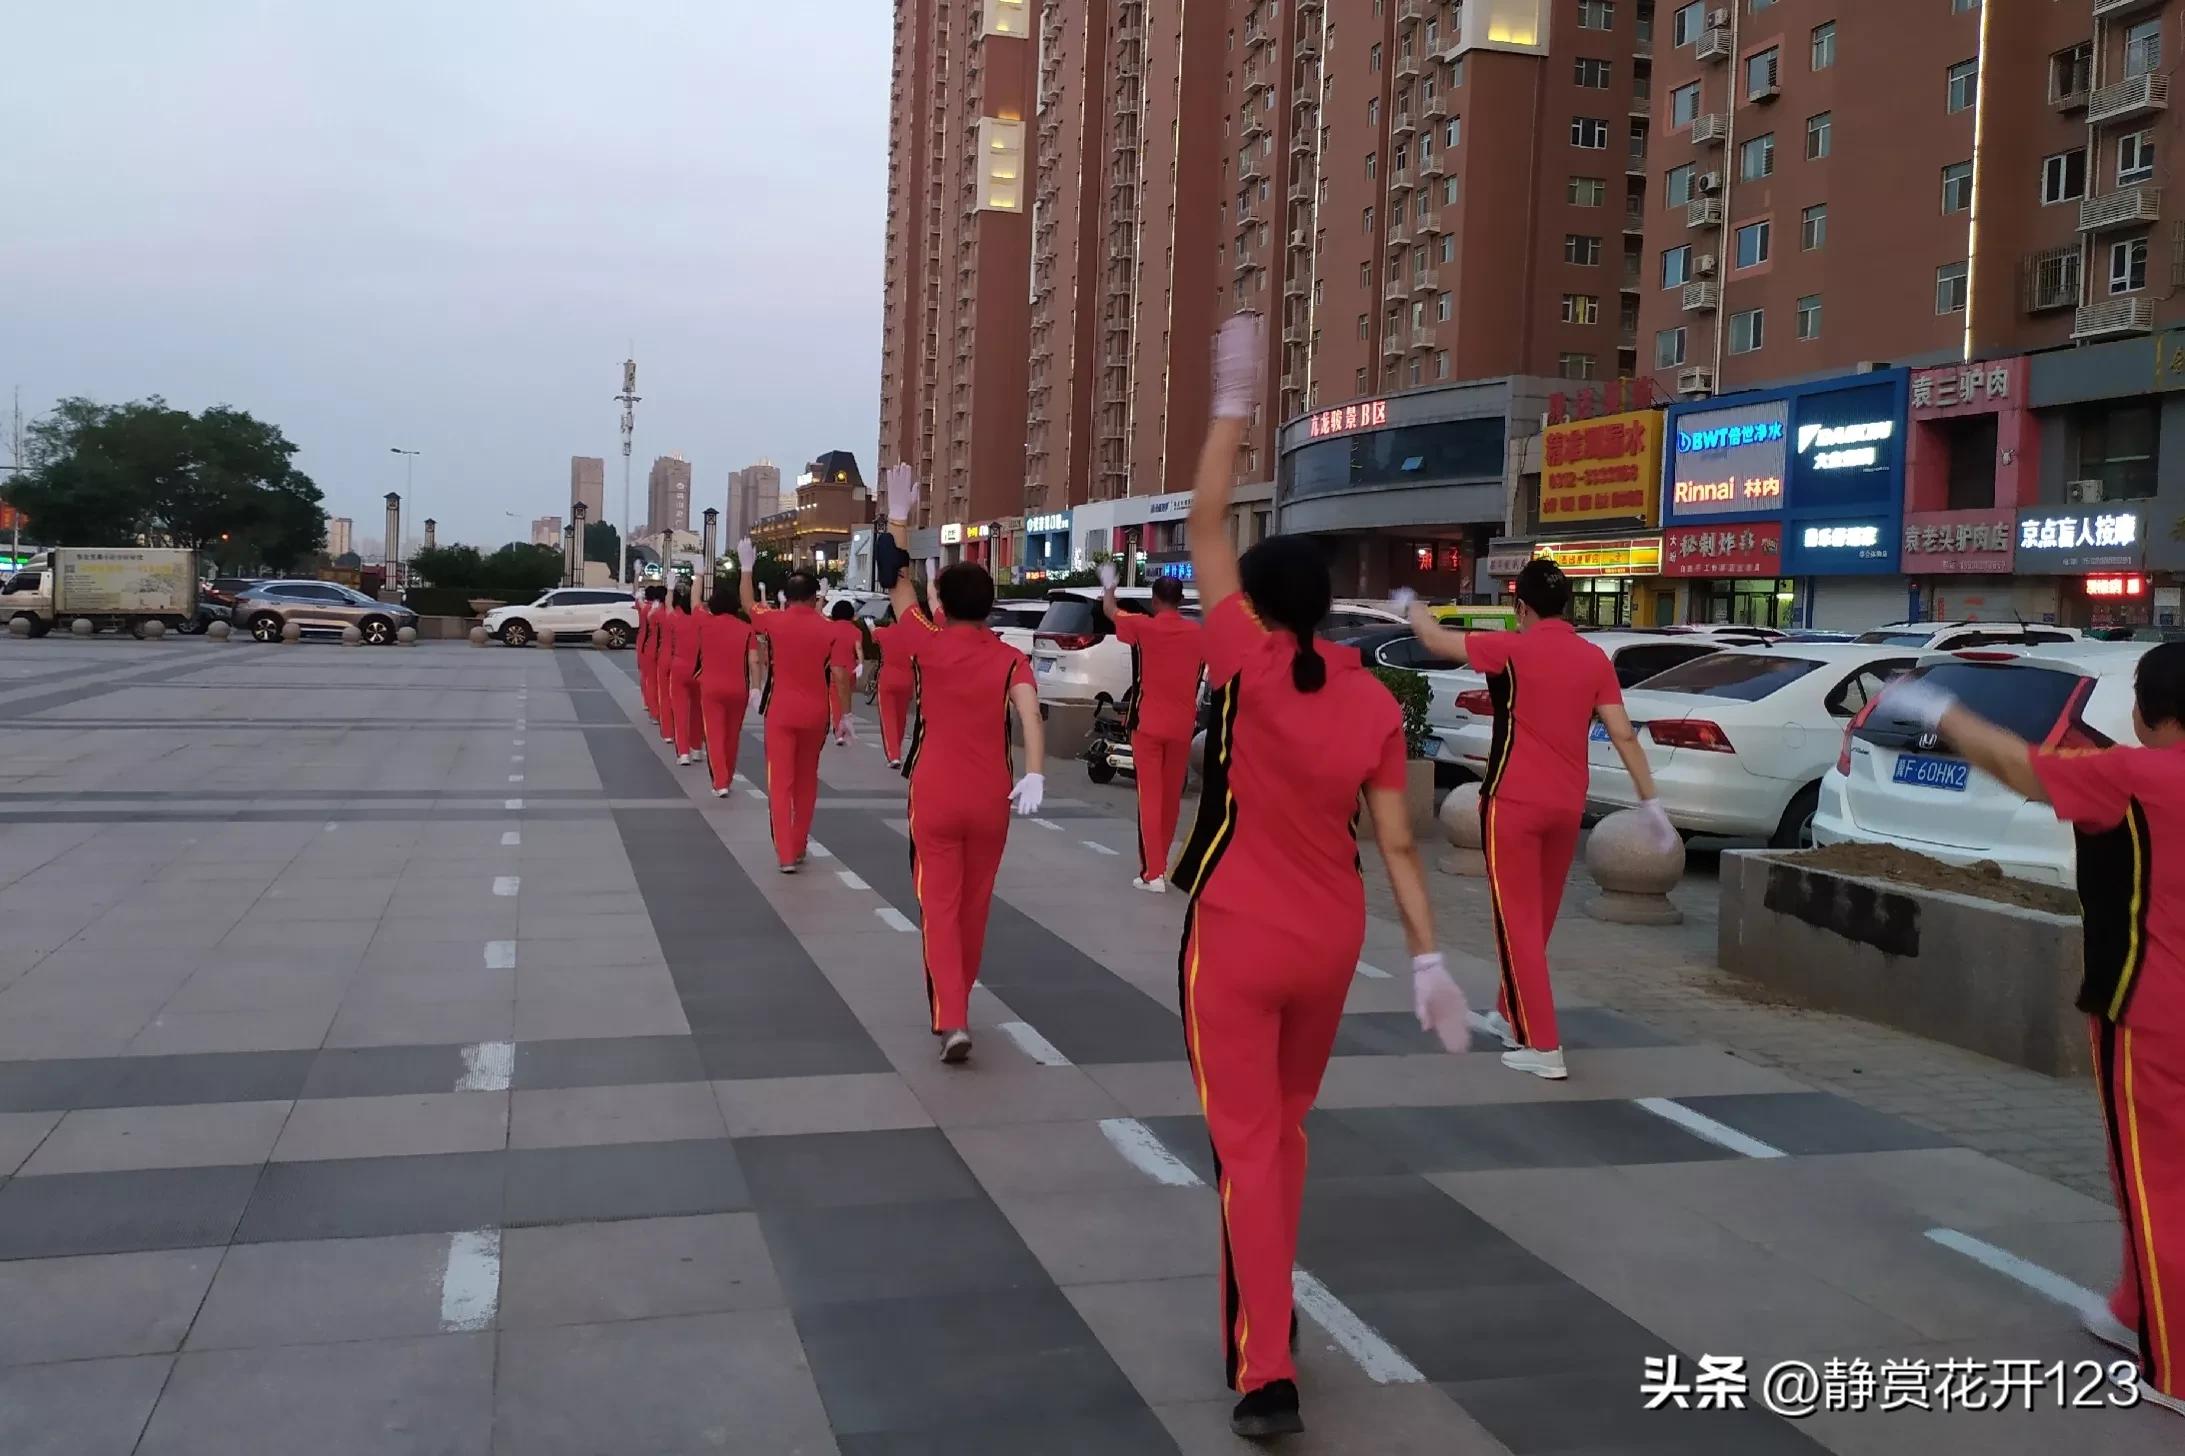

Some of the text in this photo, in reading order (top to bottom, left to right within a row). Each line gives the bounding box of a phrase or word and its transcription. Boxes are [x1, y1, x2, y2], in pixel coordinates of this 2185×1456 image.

[1911, 367, 2009, 409] 袁三驴肉
[1675, 475, 1780, 503] Rinnai 林内
[1904, 520, 2010, 554] 袁老头驴肉店
[2021, 512, 2137, 549] 京点盲人按摩
